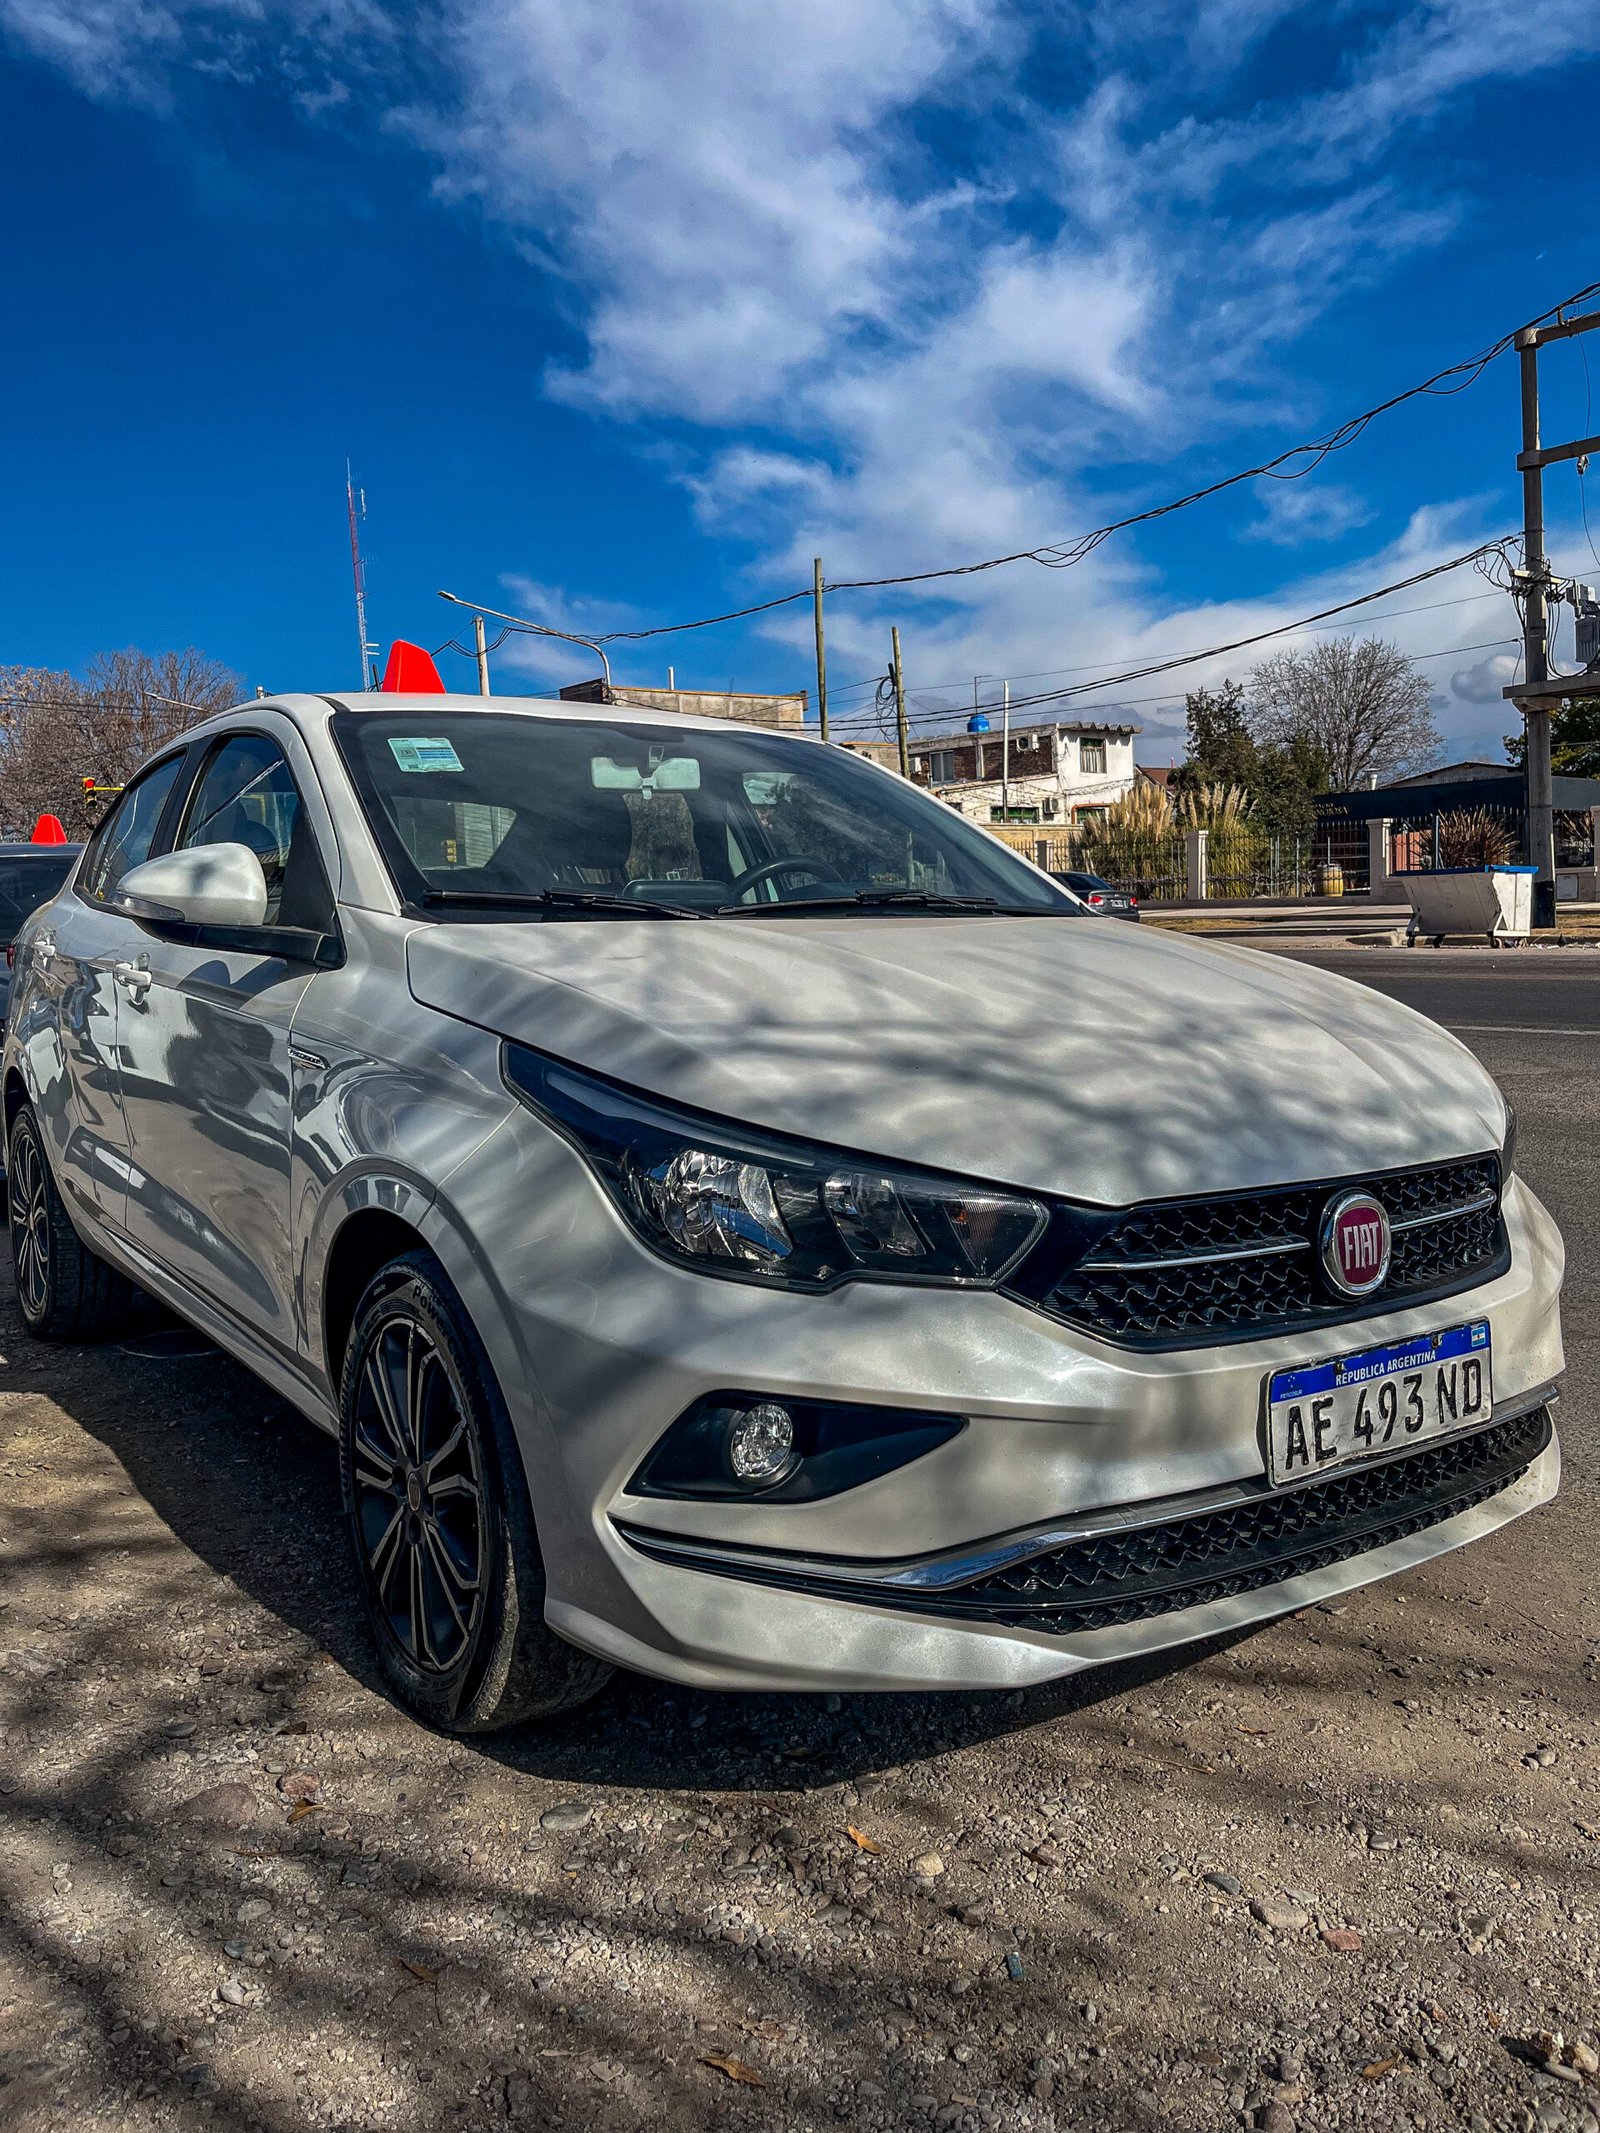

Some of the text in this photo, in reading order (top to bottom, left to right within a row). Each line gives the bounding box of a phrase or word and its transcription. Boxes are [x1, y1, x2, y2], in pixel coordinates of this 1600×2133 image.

[1343, 1221, 1379, 1270] FIAT
[1335, 1349, 1436, 1386] REPUBLICA ARGENTINA
[1285, 1358, 1483, 1470] AE 493 ND
